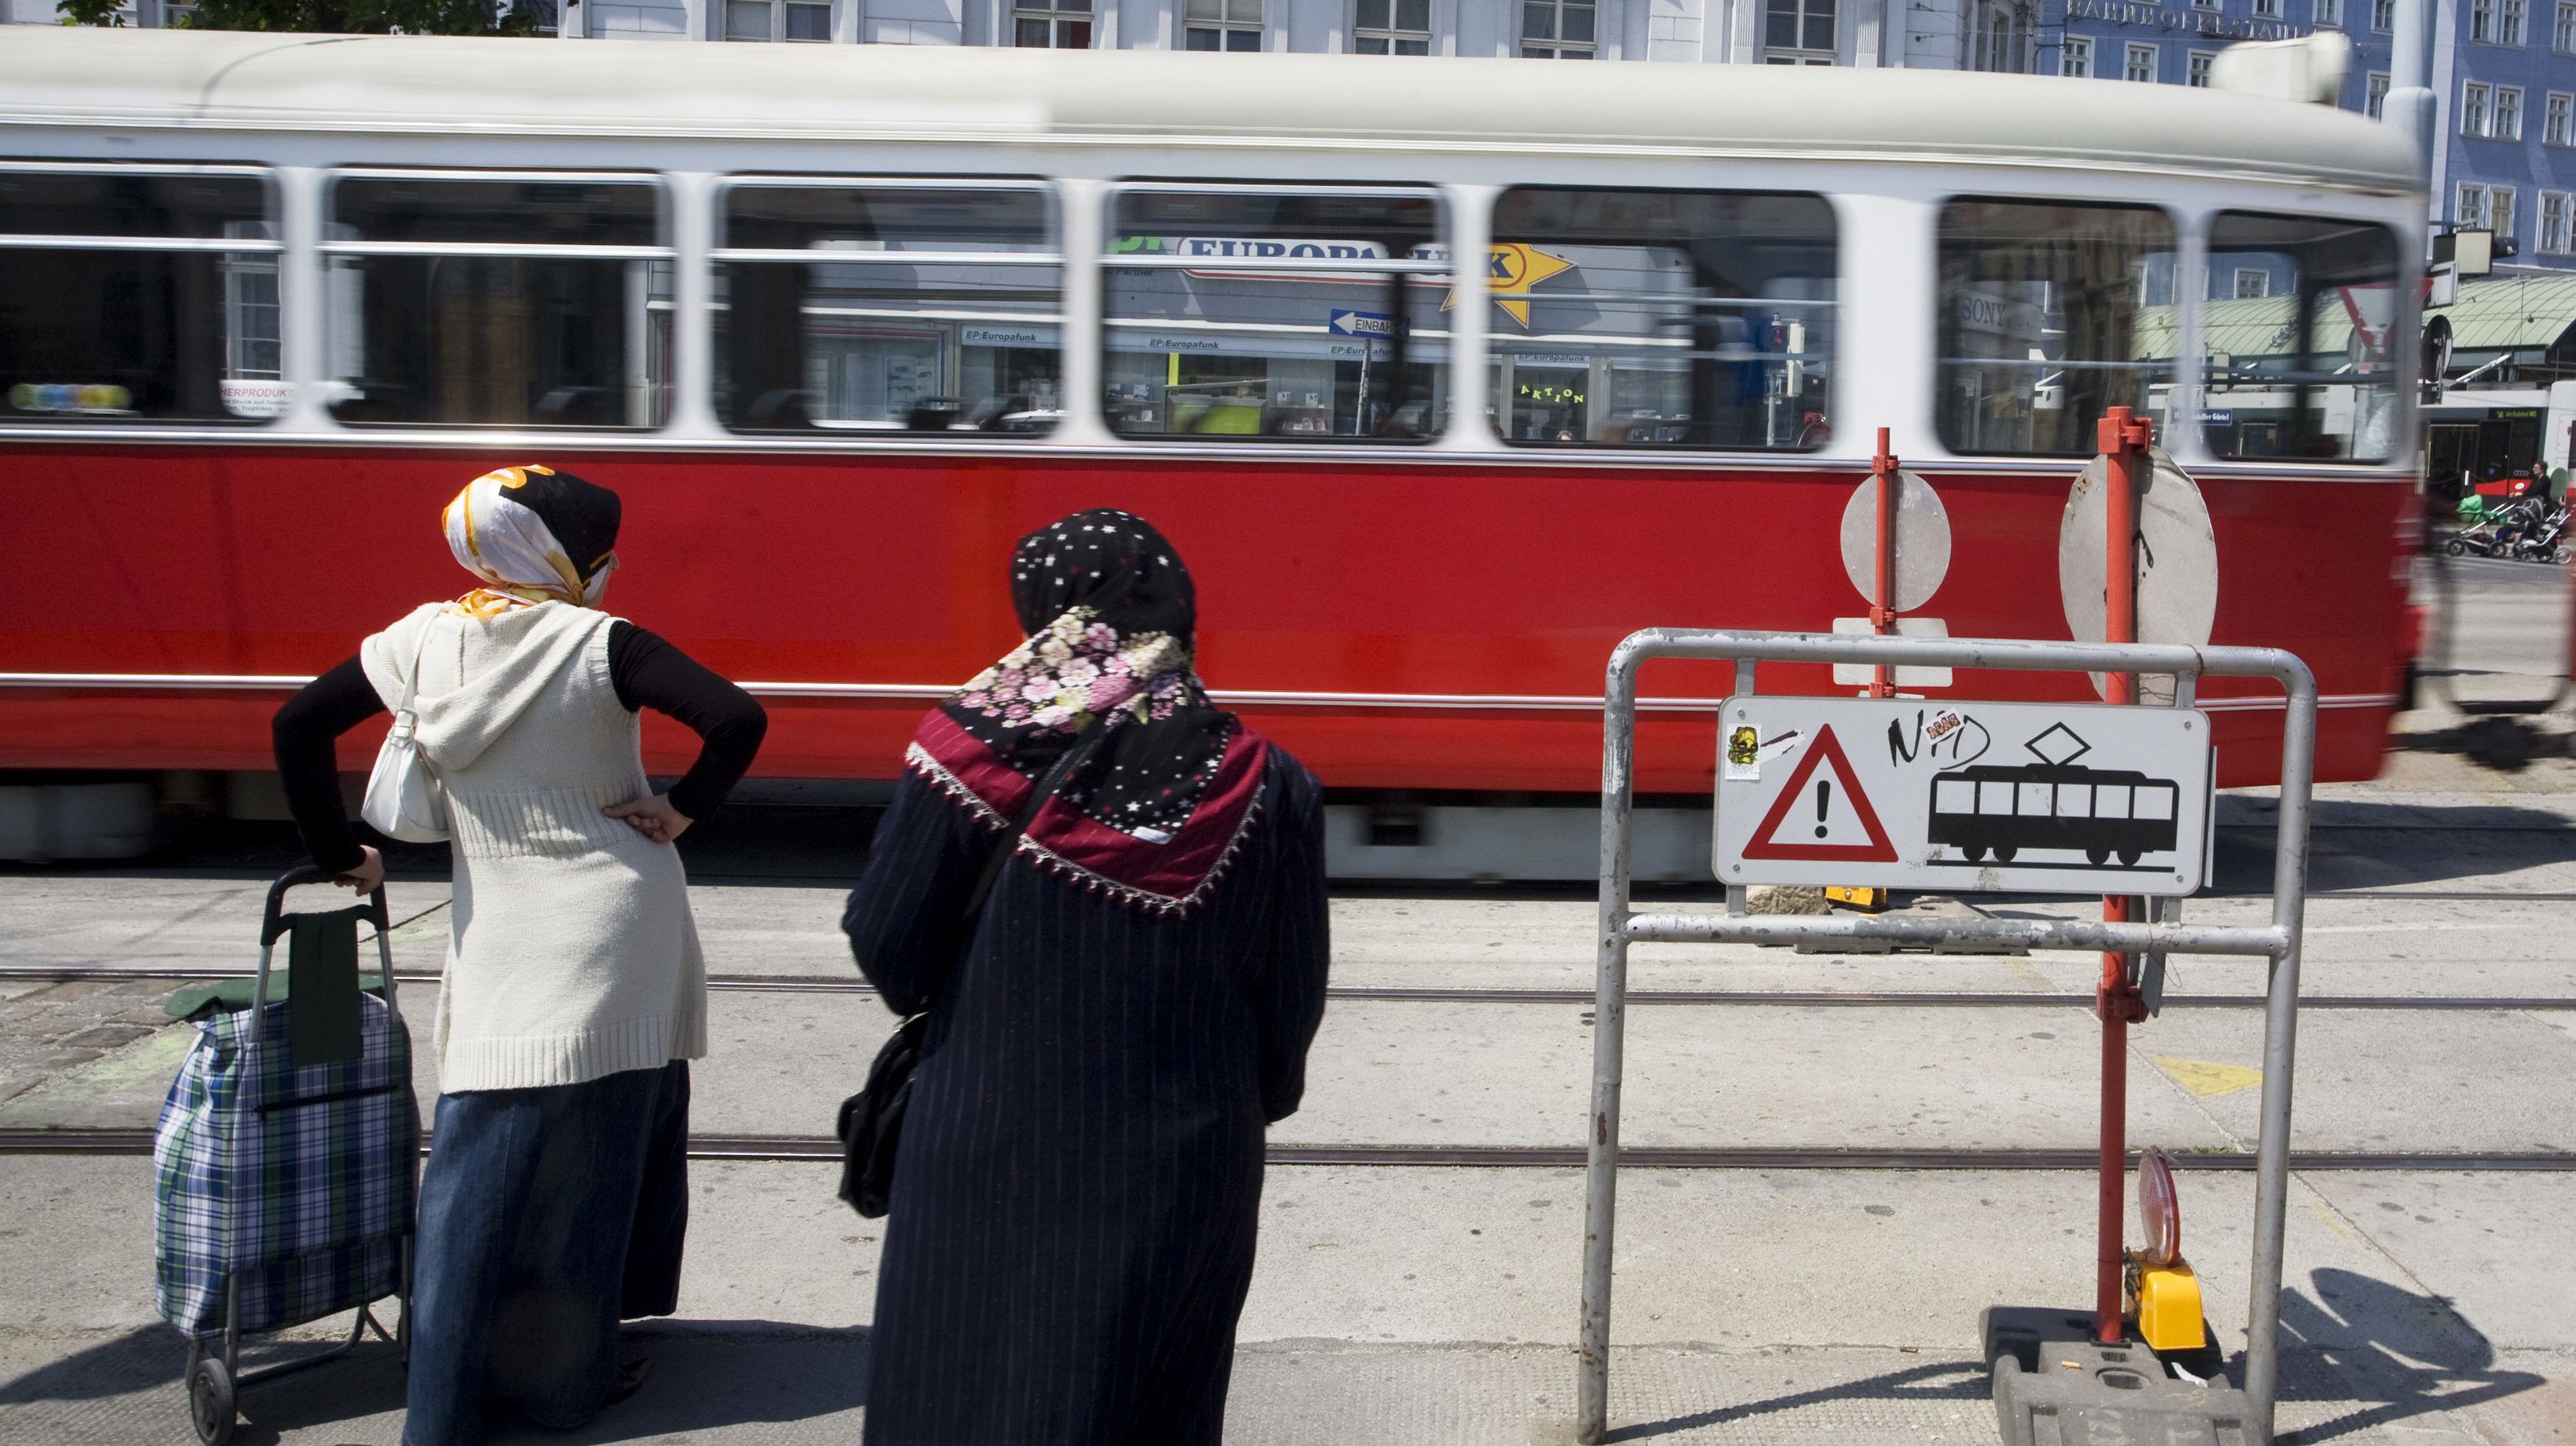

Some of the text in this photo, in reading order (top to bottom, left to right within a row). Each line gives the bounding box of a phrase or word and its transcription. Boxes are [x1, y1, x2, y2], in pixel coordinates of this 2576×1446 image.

[2067, 0, 2317, 41] BAHNHOFRESTAUR
[1961, 296, 2006, 326] SONY
[1355, 318, 1393, 333] EINBAH
[966, 330, 1036, 342] EP:Europafunk
[1150, 338, 1219, 349] EP:Europafunk
[1330, 346, 1393, 355] EP:Euroafun
[1520, 385, 1584, 403] AKTION
[2212, 413, 2230, 421] Gürtel
